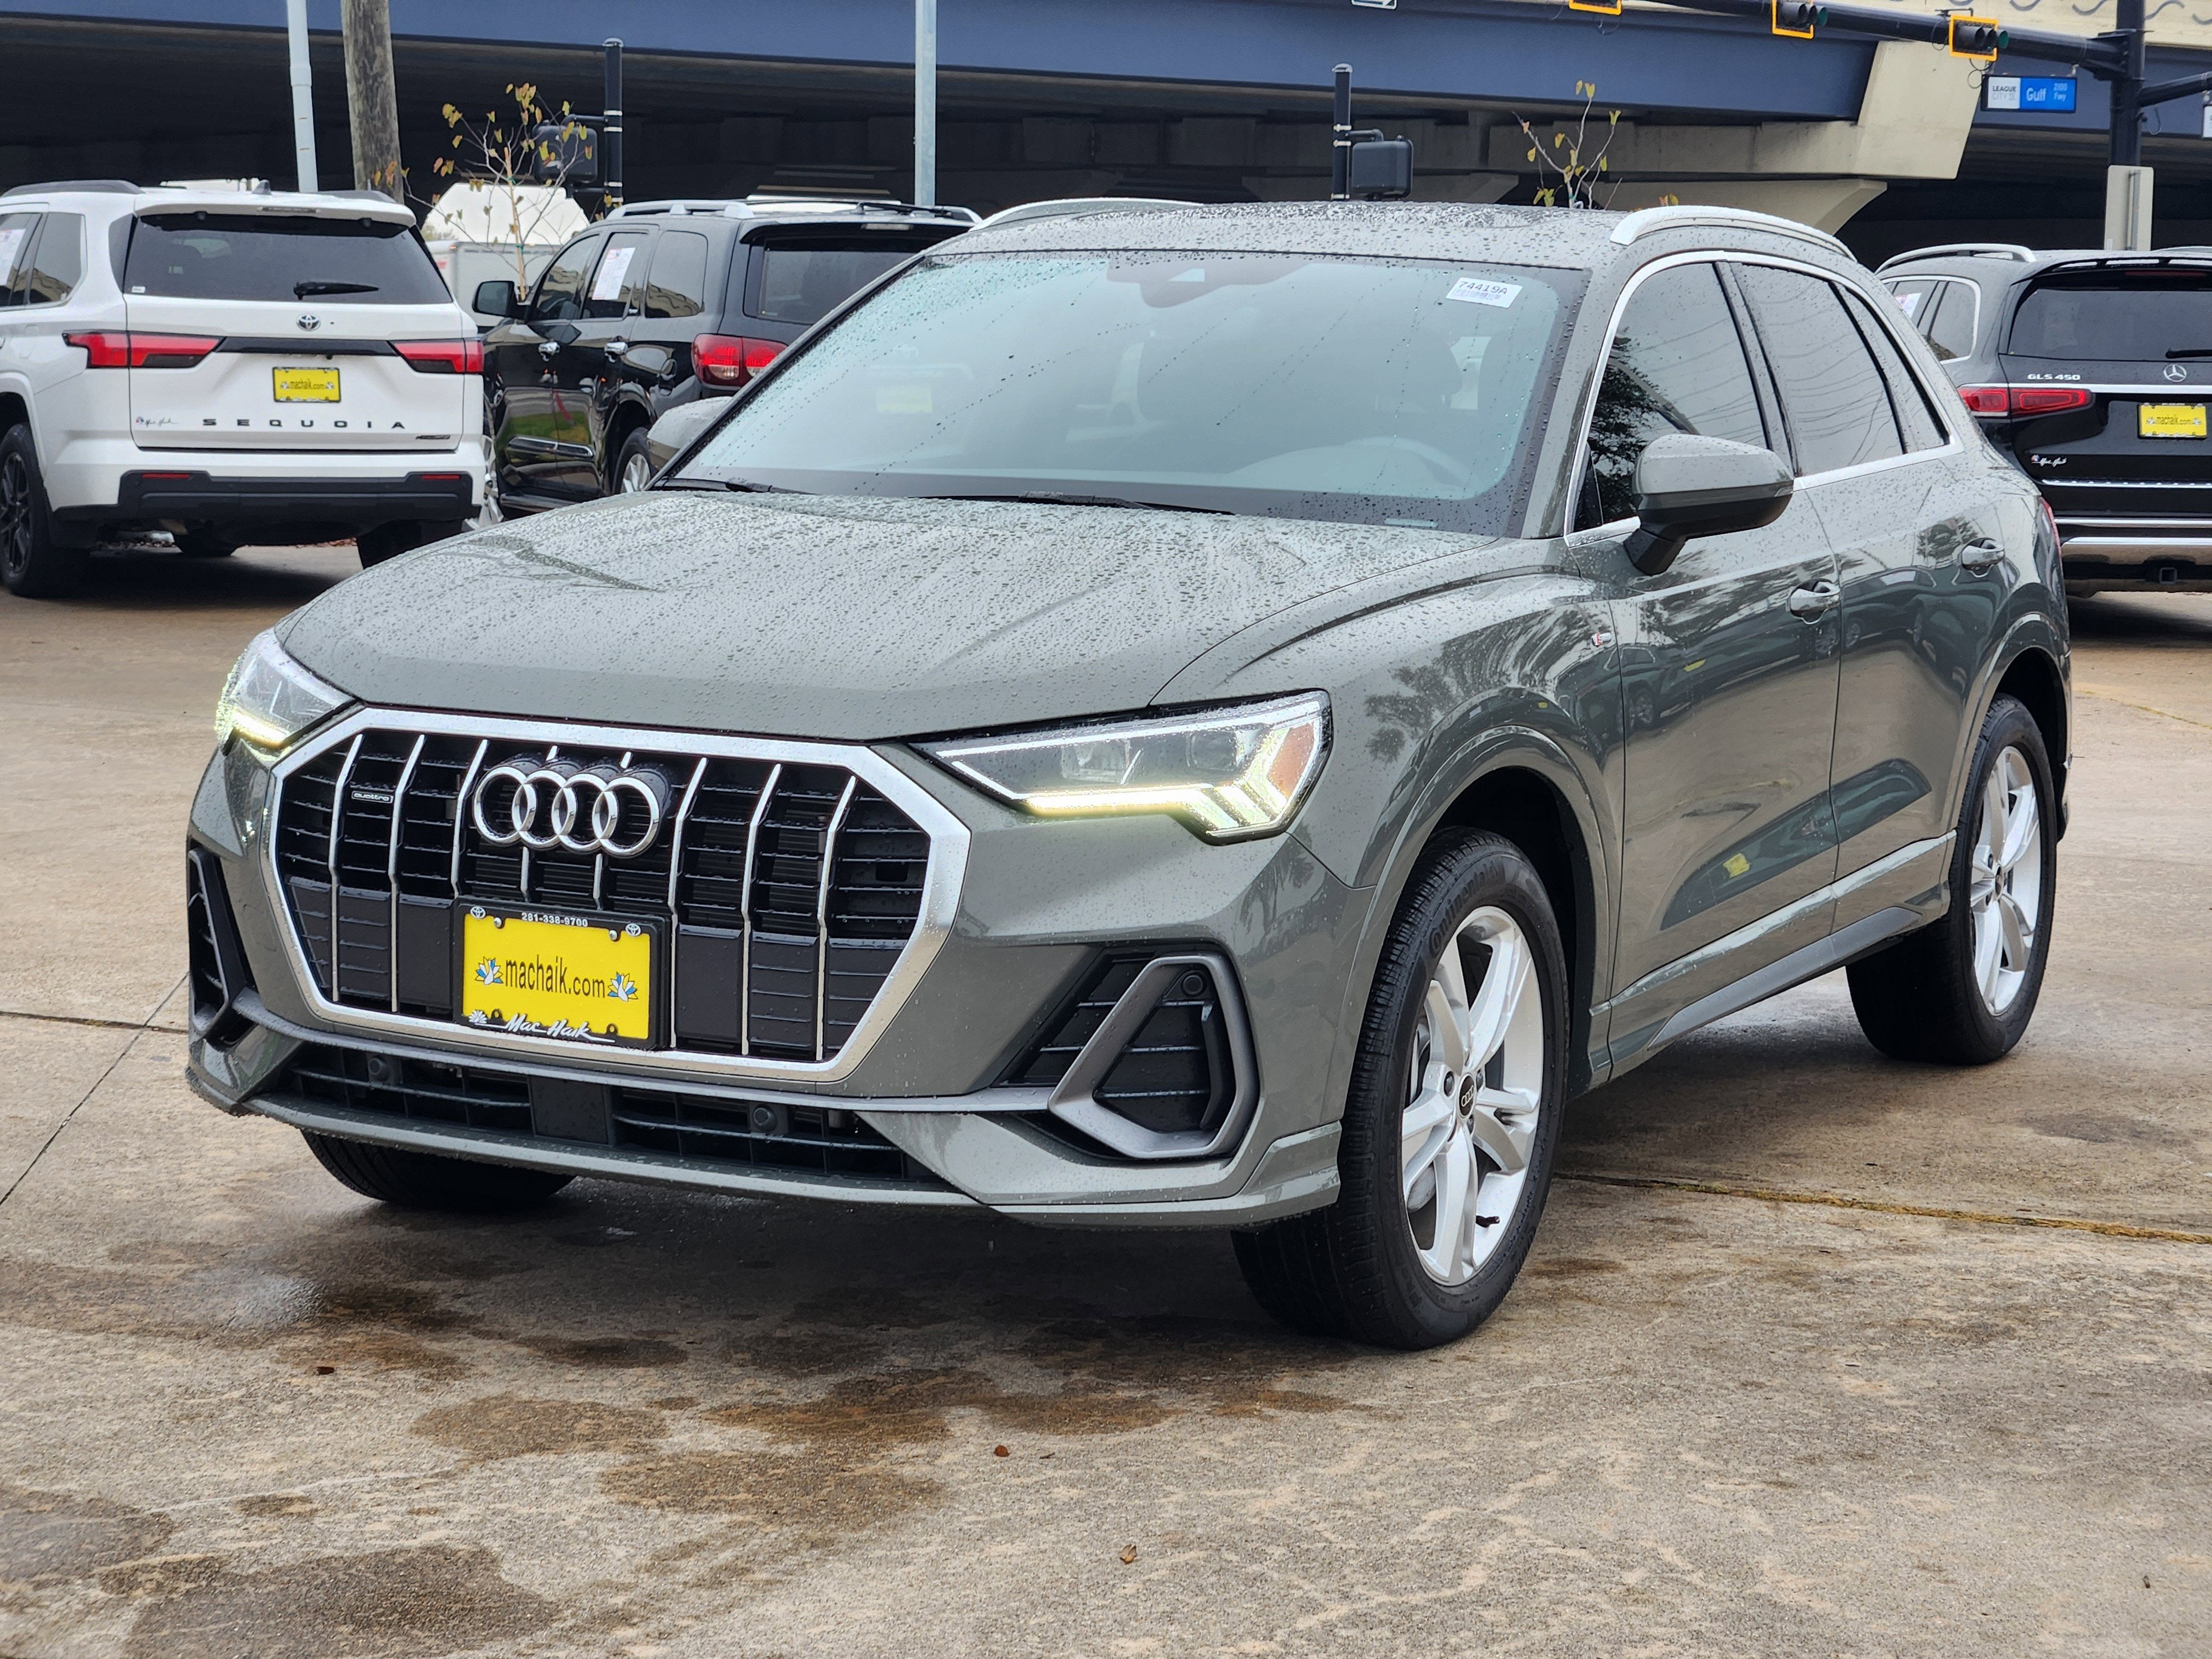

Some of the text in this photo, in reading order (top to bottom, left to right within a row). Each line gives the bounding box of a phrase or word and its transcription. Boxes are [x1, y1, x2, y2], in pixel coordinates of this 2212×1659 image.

[2026, 87, 2047, 102] Gulf
[2053, 92, 2067, 102] Fwy
[1458, 281, 1507, 295] 74419A
[203, 419, 405, 429] SEQUOIA
[353, 792, 389, 801] quattro
[521, 912, 588, 927] 281-338-9700
[505, 954, 605, 998] machaik.com
[503, 1013, 546, 1032] Mac
